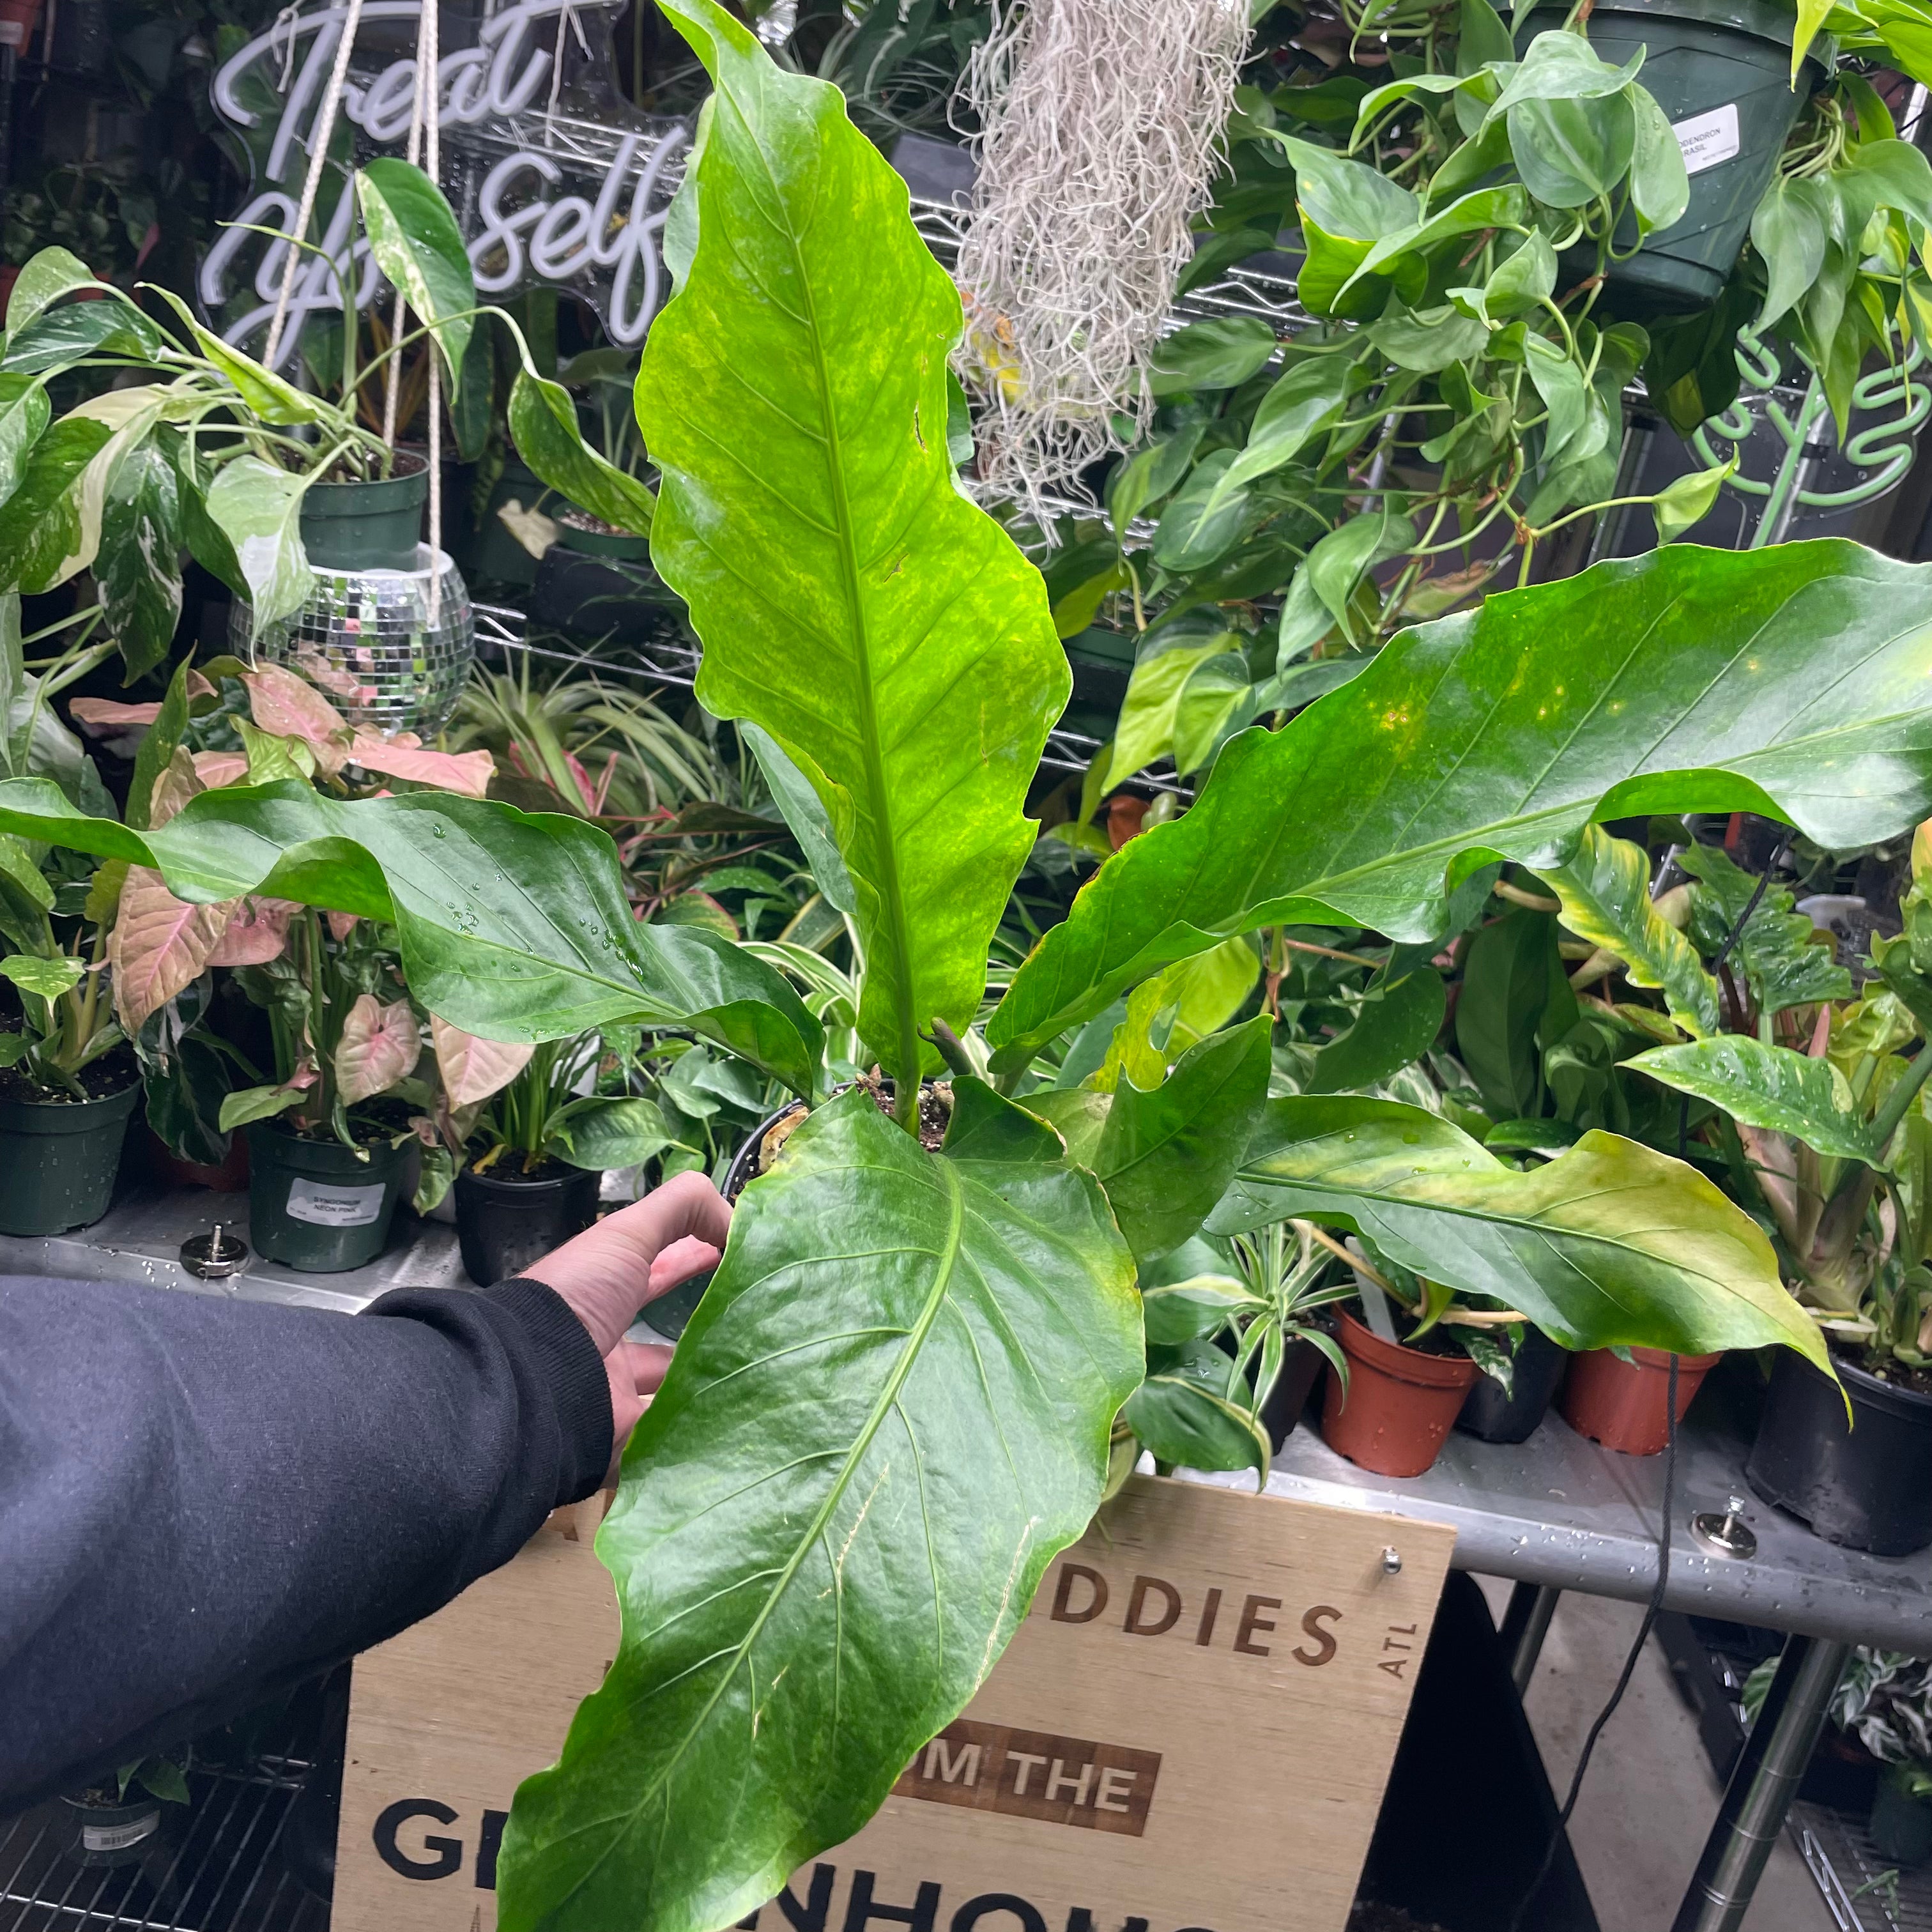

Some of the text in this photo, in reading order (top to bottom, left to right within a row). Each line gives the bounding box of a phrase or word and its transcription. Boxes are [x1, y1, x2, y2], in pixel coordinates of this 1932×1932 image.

[214, 0, 626, 183] Treat
[1683, 144, 1708, 157] RASIL
[467, 126, 687, 344] Self
[313, 1204, 336, 1213] NEON
[1029, 1562, 1343, 1667] DDIES
[1377, 1622, 1418, 1680] ATL
[1006, 1750, 1138, 1813] THE
